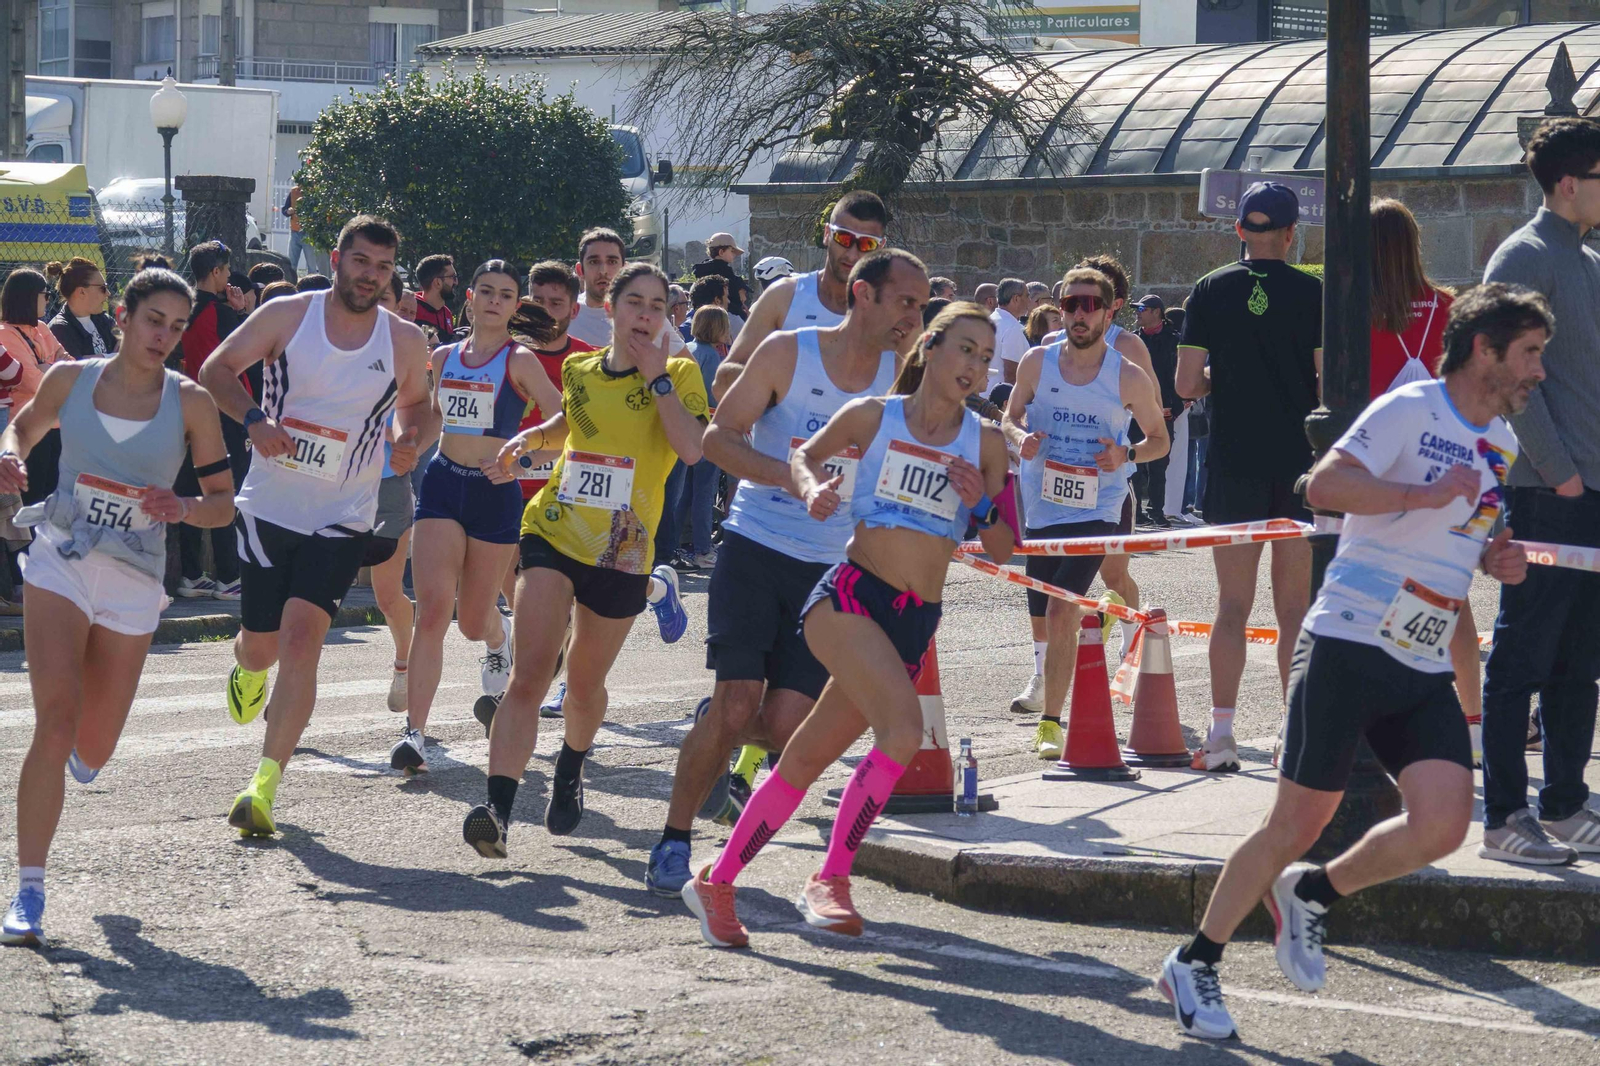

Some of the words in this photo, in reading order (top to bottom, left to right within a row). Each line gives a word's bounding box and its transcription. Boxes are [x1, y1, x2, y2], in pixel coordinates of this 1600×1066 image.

[1047, 16, 1130, 28] Particulares
[1300, 186, 1316, 196] de
[447, 395, 479, 419] 284
[1418, 447, 1444, 463] PRAIA
[1420, 432, 1474, 463] CARREIRA
[450, 464, 467, 477] NIKE
[577, 470, 612, 498] 281
[899, 463, 949, 502] 1012
[1053, 477, 1085, 500] 685
[108, 494, 141, 506] RAMALHOS
[86, 496, 133, 532] 554
[1403, 611, 1448, 646] 469
